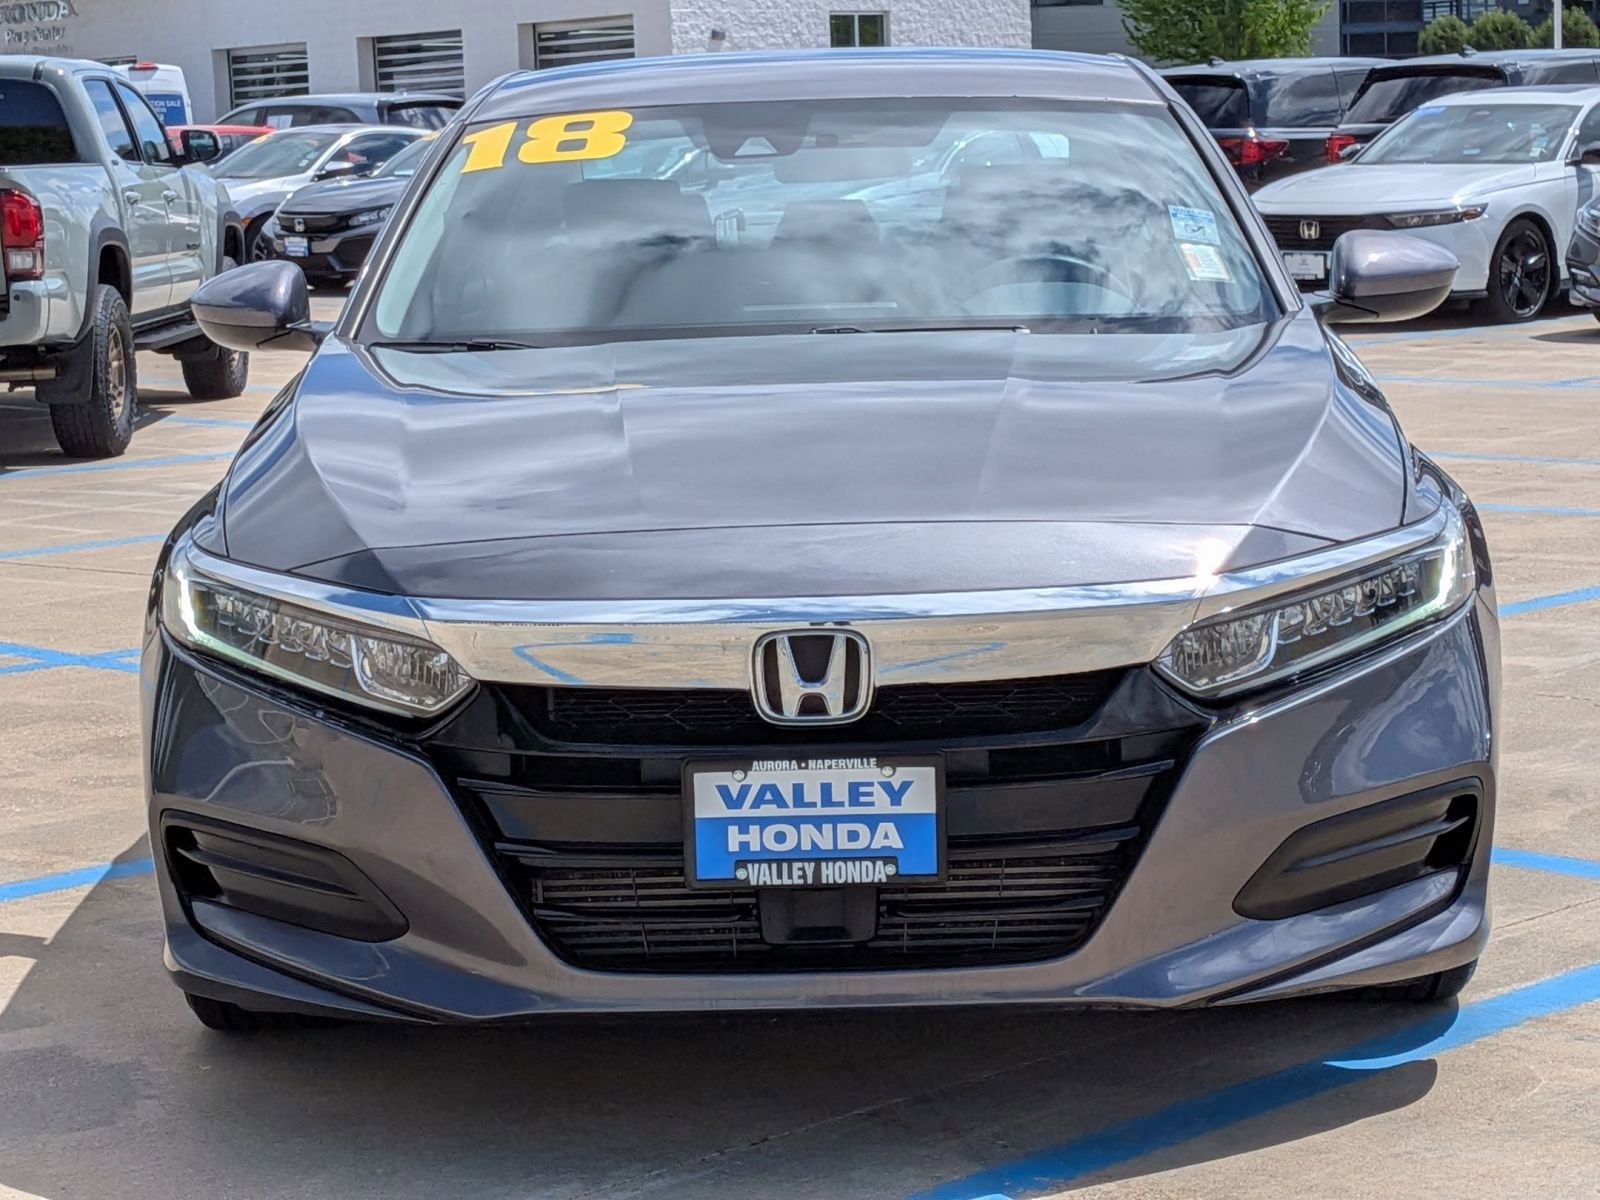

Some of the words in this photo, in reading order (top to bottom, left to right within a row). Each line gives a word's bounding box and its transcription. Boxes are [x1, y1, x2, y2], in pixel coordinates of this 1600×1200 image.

[460, 109, 634, 174] 18
[751, 760, 798, 771] AURORA
[808, 758, 878, 770] NAPERVILLE
[714, 780, 915, 811] VALLEY
[727, 822, 905, 853] HONDA
[746, 861, 816, 886] VALLEY
[821, 860, 887, 885] HONDA
